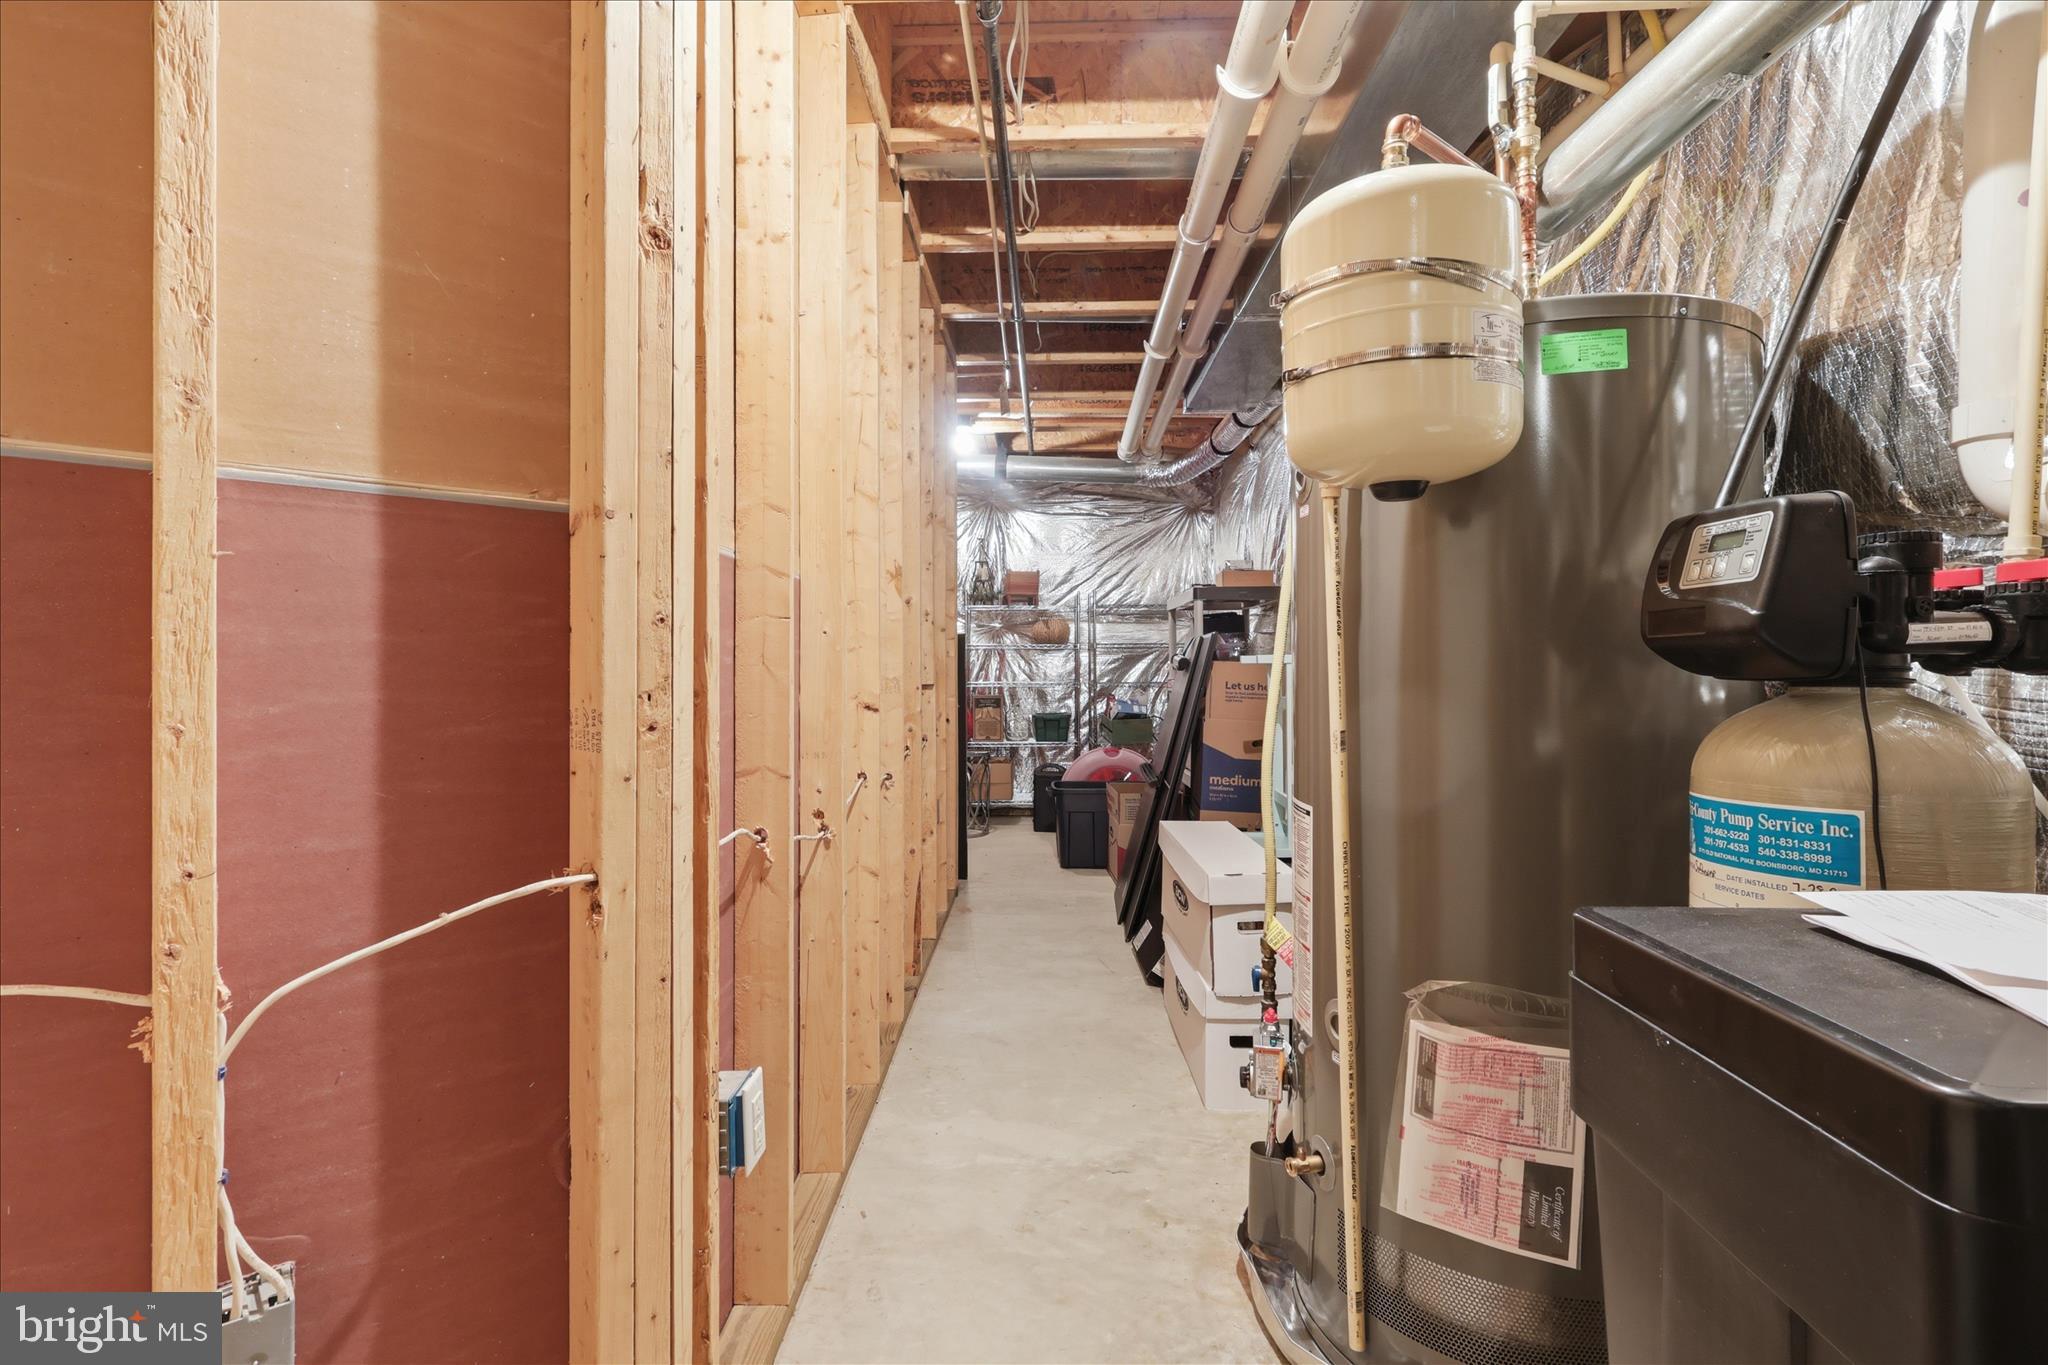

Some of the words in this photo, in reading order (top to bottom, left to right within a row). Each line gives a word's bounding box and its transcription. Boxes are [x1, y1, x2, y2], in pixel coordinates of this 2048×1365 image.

[1225, 681, 1242, 690] Let
[1244, 683, 1256, 691] us
[1209, 774, 1261, 787] medium
[1720, 807, 1754, 831] Pump
[1758, 813, 1815, 834] Service
[1821, 819, 1854, 838] Inc.
[1758, 834, 1831, 852] 301-831-8331
[1758, 846, 1833, 864] 540-338-8998
[1342, 841, 1350, 890] CHARLOTTE
[1756, 859, 1808, 874] BOONSBORO,
[1809, 867, 1822, 875] MD
[1823, 869, 1849, 878] 21713
[1715, 883, 1740, 896] SERVICE
[1741, 889, 1766, 901] DATES
[1726, 874, 1744, 884] DATE
[1744, 878, 1788, 892] INSTALLED
[1462, 1094, 1504, 1105] IMPORTANT
[1456, 1159, 1502, 1177] IMPORTANT
[1526, 1189, 1539, 1227] Warranty
[1541, 1195, 1552, 1228] Limited
[1552, 1186, 1566, 1230] Certificate
[1550, 1230, 1563, 1243] of
